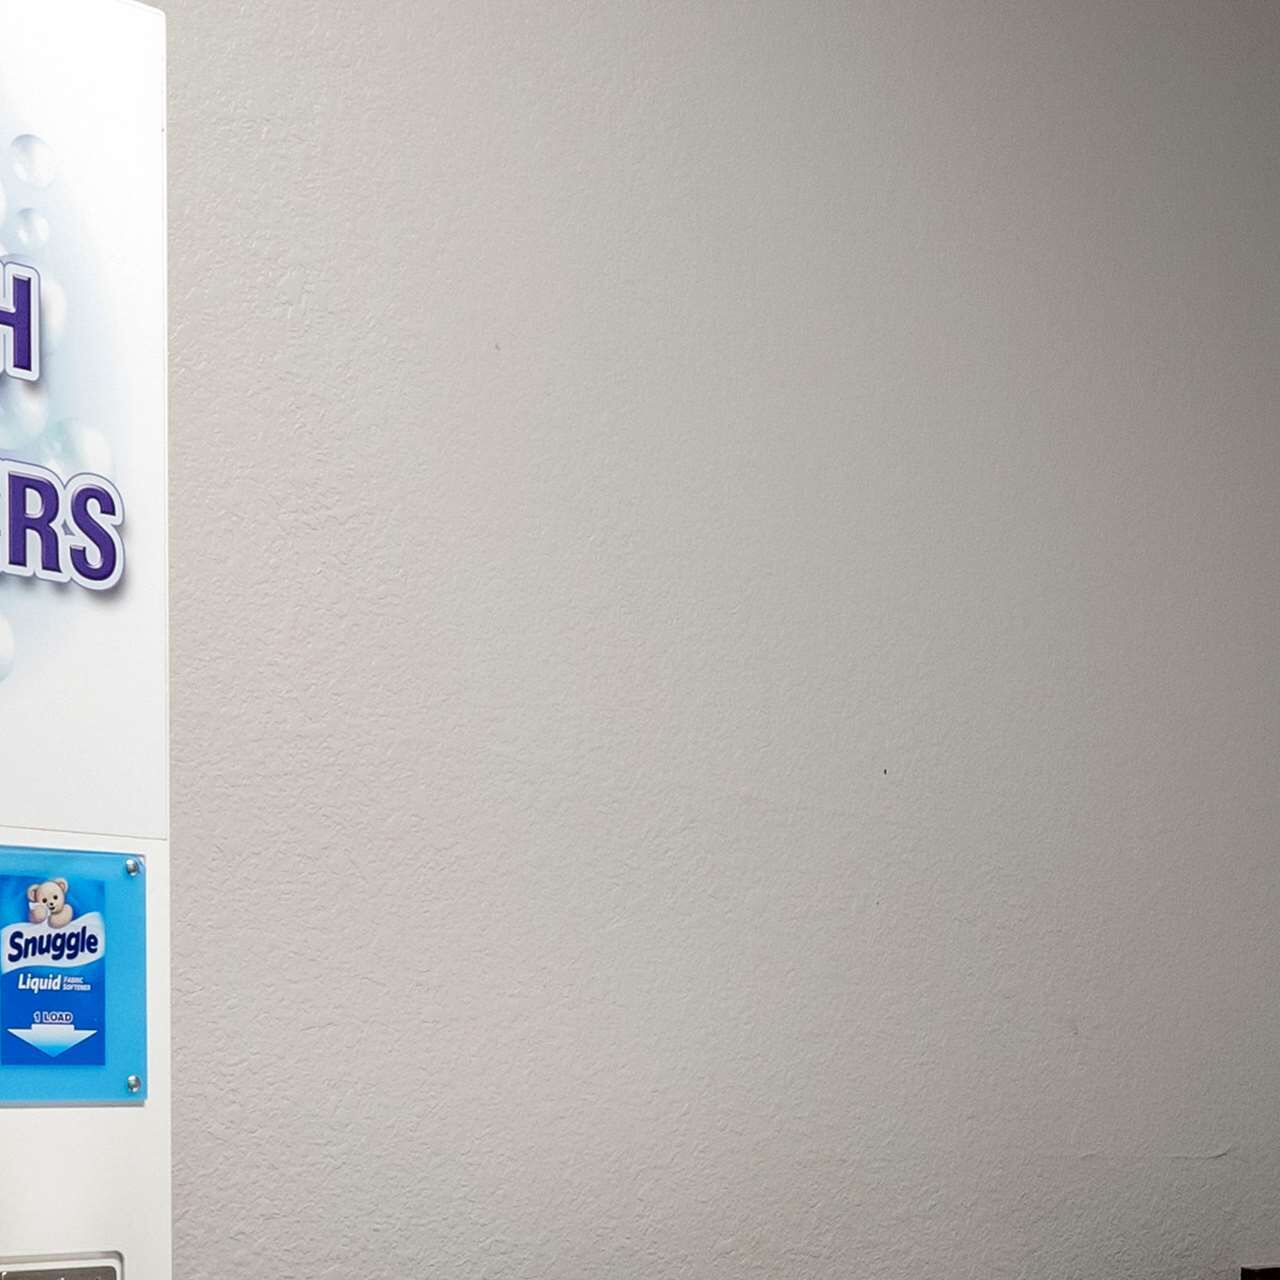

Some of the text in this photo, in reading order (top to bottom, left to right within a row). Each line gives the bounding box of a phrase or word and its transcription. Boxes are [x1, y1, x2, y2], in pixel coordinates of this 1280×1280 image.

[7, 926, 98, 962] Snuggle
[18, 973, 61, 994] Liquid
[34, 1012, 73, 1022] 1 LOAD
